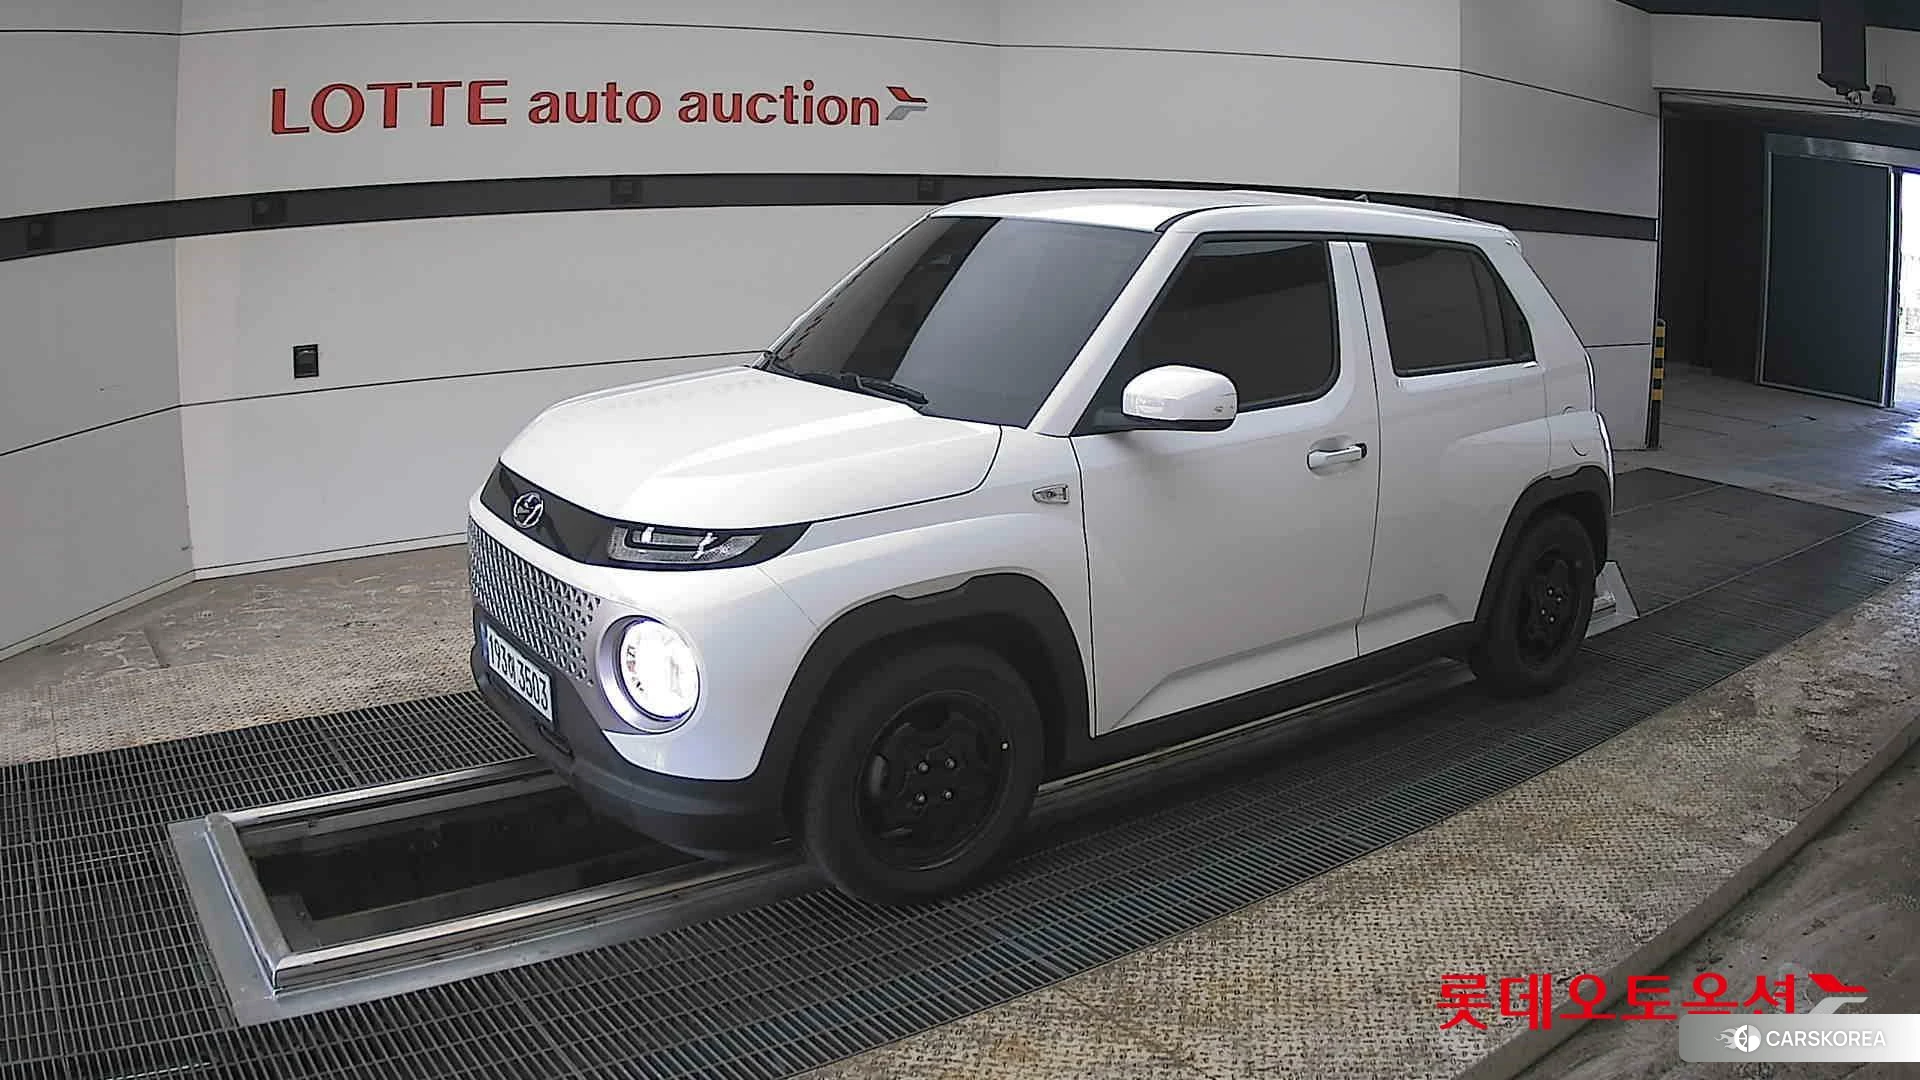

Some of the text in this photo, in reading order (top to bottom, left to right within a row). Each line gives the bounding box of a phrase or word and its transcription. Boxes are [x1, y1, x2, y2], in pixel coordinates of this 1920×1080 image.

[271, 80, 879, 134] LOTTE auto auction
[517, 660, 547, 710] 3503
